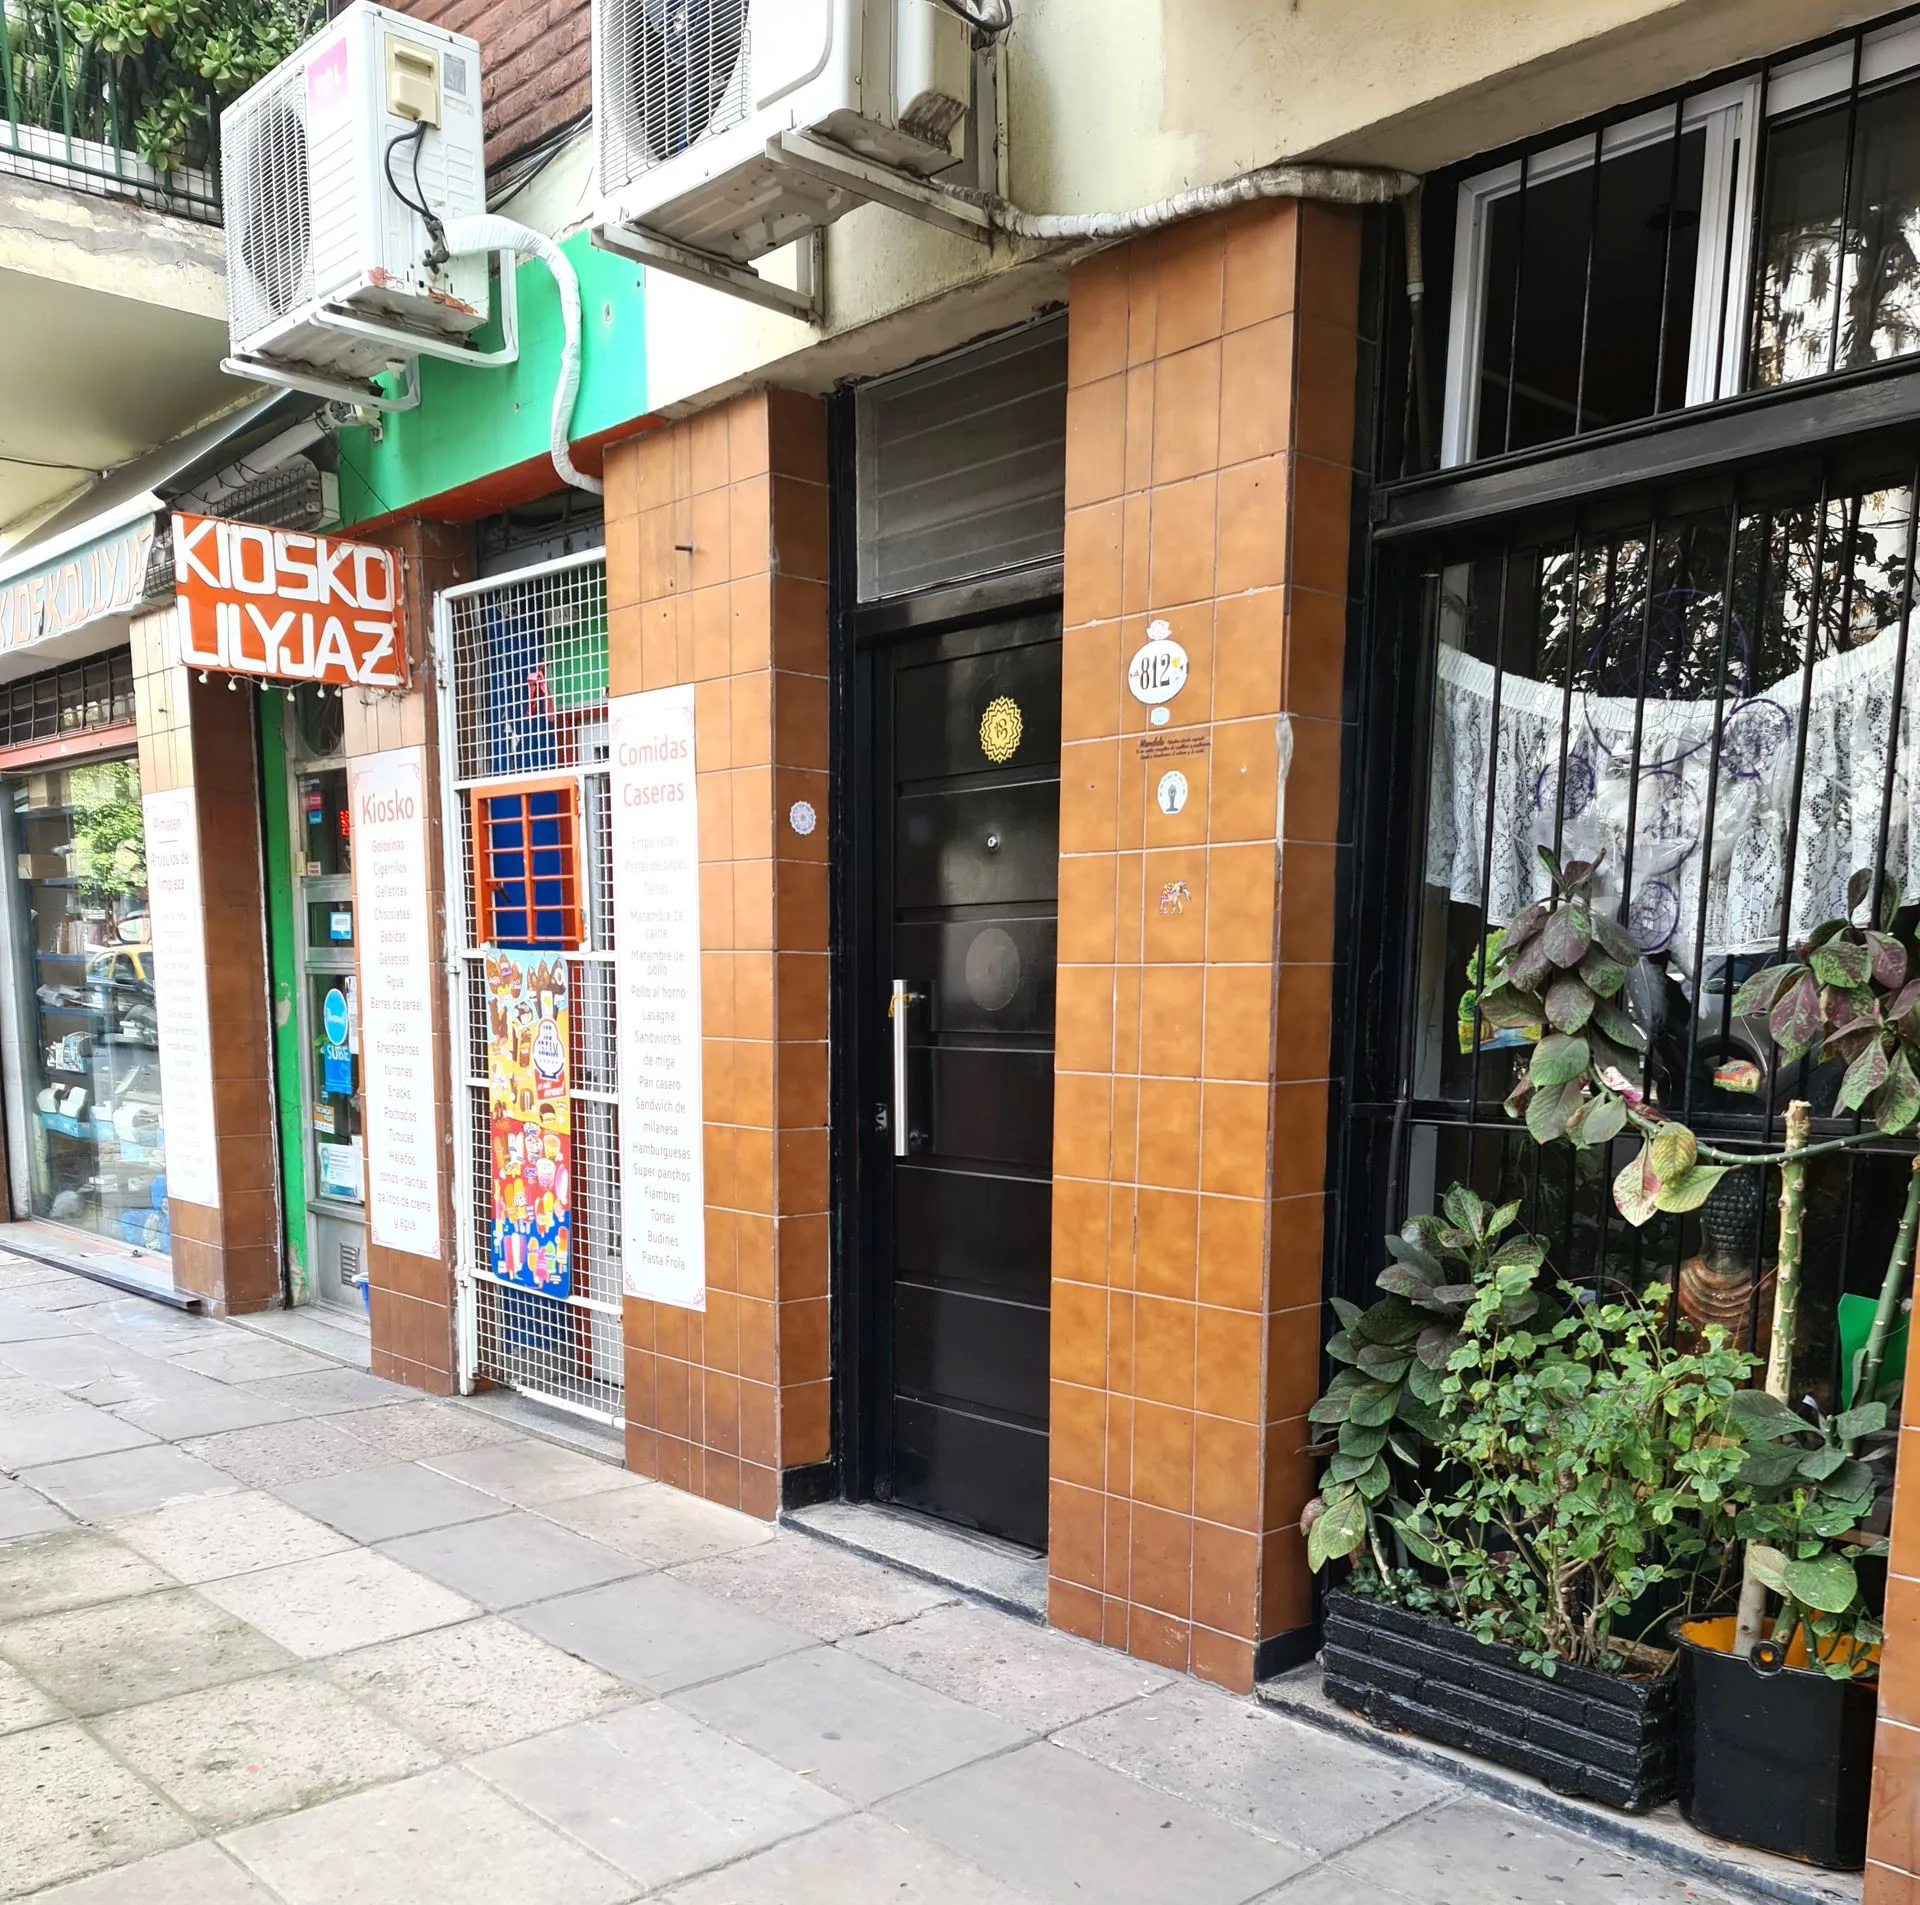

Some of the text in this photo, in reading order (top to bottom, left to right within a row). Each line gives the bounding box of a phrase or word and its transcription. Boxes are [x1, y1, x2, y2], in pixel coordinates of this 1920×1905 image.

[171, 514, 396, 612] KIOSKO
[176, 594, 400, 686] LILYJAZ
[1140, 653, 1171, 690] 812
[618, 734, 688, 766] Comidas
[623, 781, 685, 807] Caseras
[361, 788, 414, 825] Kiosko
[372, 837, 406, 853] Golosinas
[373, 859, 408, 879] Cigarrillos
[374, 907, 411, 921] Chocolates
[673, 910, 684, 922] de
[380, 928, 406, 943] Bebidas
[378, 952, 410, 966] Gaseosas
[631, 949, 685, 962] Matambre de
[647, 961, 668, 978] pollo
[631, 984, 686, 1000] Pollo al horno
[370, 996, 391, 1010] Barras
[392, 998, 401, 1010] de
[641, 1006, 675, 1024] Lasagna
[634, 1029, 682, 1046] Sandwiches
[326, 1045, 350, 1061] SUBE
[376, 1040, 420, 1057] Energizantes
[643, 1053, 675, 1071] de miga
[639, 1075, 682, 1091] Pan casero
[388, 1084, 411, 1100] Snacks
[635, 1096, 686, 1114] Sandwich de
[643, 1119, 678, 1136] milanesa
[388, 1150, 416, 1166] Helados
[632, 1141, 691, 1160] Hamburguesas
[633, 1162, 691, 1183] Super panchos
[644, 1185, 680, 1204] Fiambres
[650, 1208, 675, 1225] Tortas
[647, 1230, 679, 1247] Budines
[641, 1250, 686, 1271] Pasta Frola
